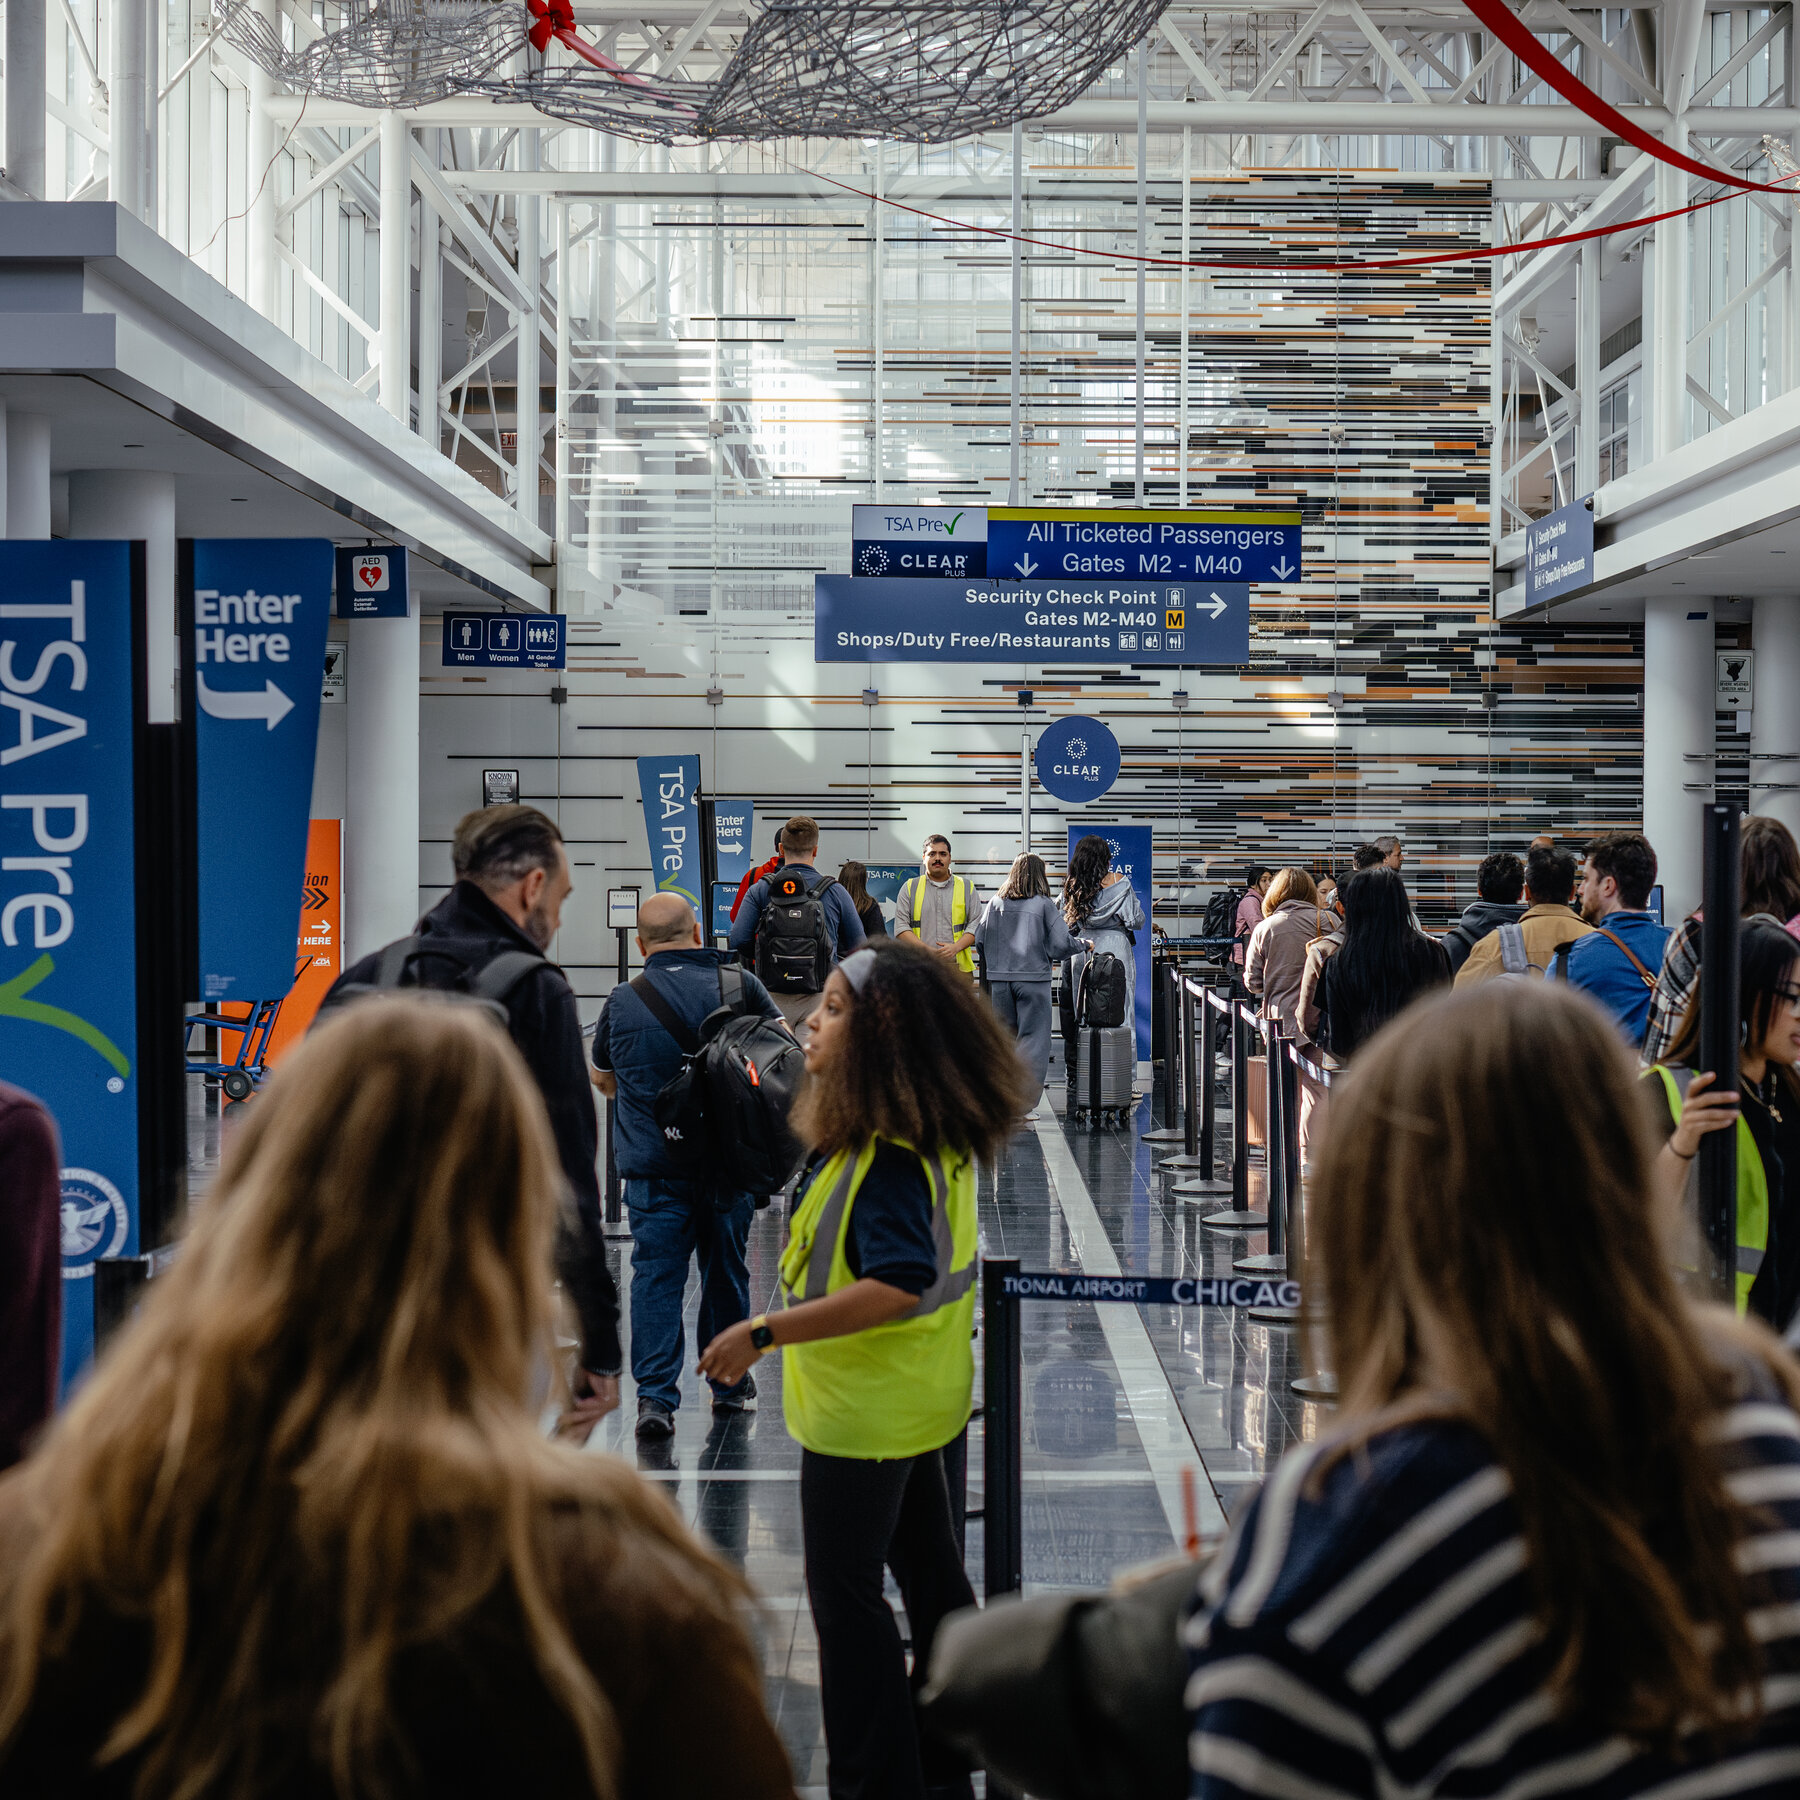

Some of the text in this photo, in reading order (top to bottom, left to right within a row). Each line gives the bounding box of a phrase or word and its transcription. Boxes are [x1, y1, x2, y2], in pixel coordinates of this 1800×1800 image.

[884, 517, 943, 532] TSA Pre
[1027, 522, 1285, 550] All Ticketed Passengers
[362, 557, 380, 565] AED
[900, 554, 966, 568] CLEAR
[1062, 553, 1125, 573] Gates
[1139, 554, 1172, 573] M2
[1195, 555, 1242, 575] M40
[945, 569, 966, 577] PLUS
[965, 588, 1157, 607] Security Check Point
[195, 589, 302, 625] Enter
[1025, 611, 1157, 626] Gates M2-M40
[1168, 612, 1183, 627] M
[197, 628, 291, 663] Here
[837, 631, 1111, 649] Shops/Duty Free/Restaurants
[457, 653, 475, 661] Men
[489, 653, 519, 662] Women
[0, 580, 89, 949] TSA Pre
[1053, 764, 1100, 776] CLEAR
[488, 772, 513, 780] KNOWN
[659, 766, 687, 871] TSA Pre
[716, 815, 744, 826] Enter
[717, 826, 742, 837] Here
[866, 870, 895, 879] TSA Pre
[1108, 864, 1132, 874] EAR
[304, 872, 329, 886] ion
[303, 936, 332, 945] HERE
[1004, 1276, 1302, 1308] TIONAL AIRPORT CHICAG
